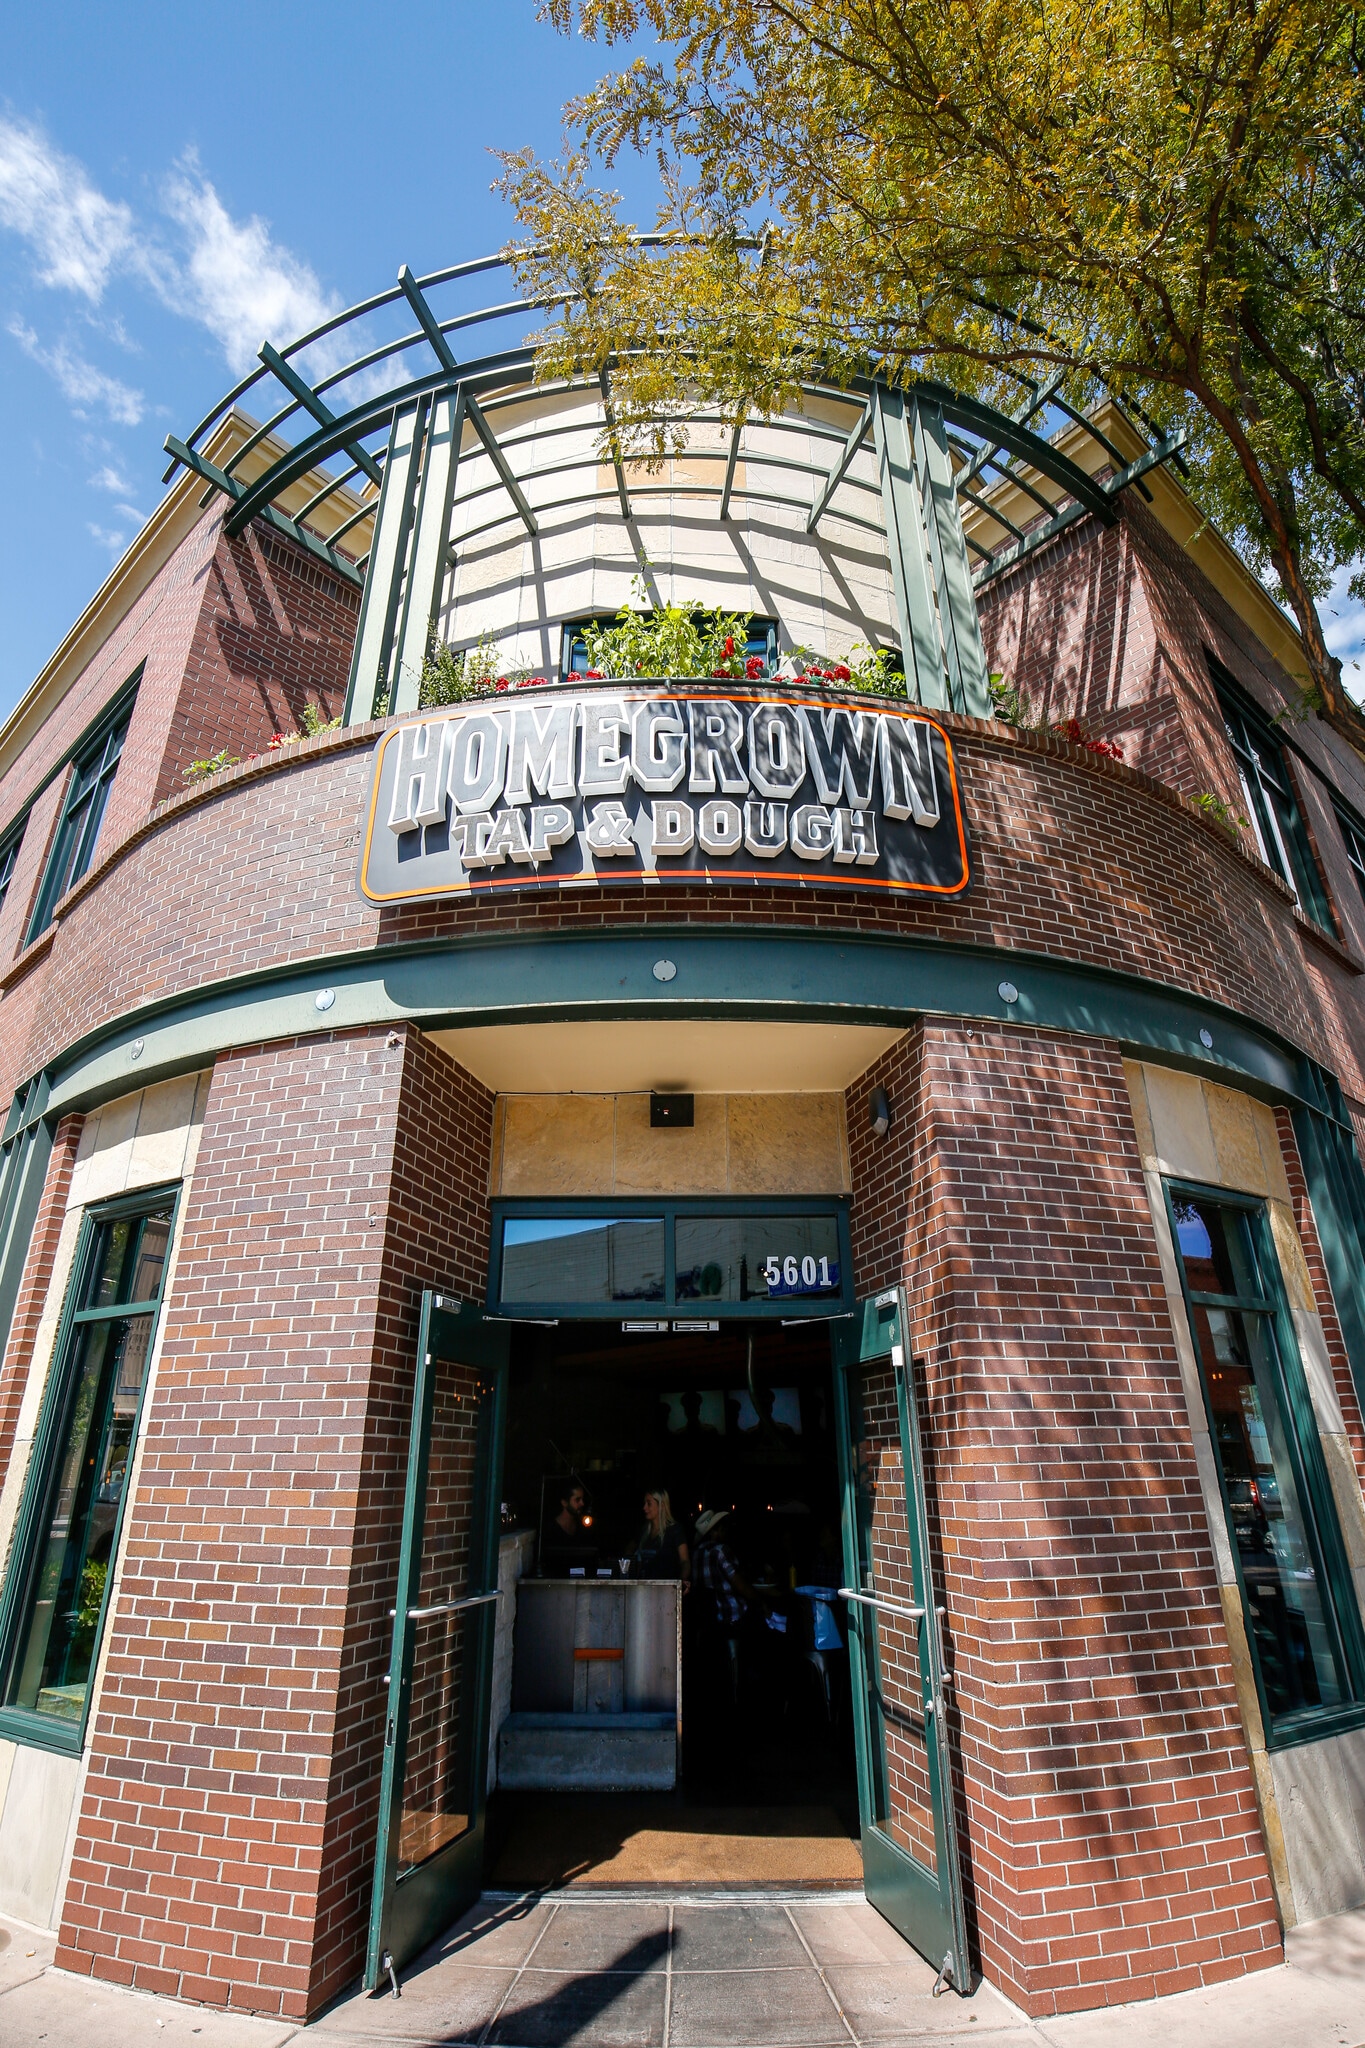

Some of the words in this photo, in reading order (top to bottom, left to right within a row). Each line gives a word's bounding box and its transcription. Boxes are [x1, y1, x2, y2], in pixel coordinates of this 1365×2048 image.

[387, 699, 941, 829] HOMEGROWN
[452, 805, 575, 868] TAP
[586, 800, 636, 858] &
[651, 801, 881, 866] DOUGH
[767, 1256, 832, 1286] 5601
